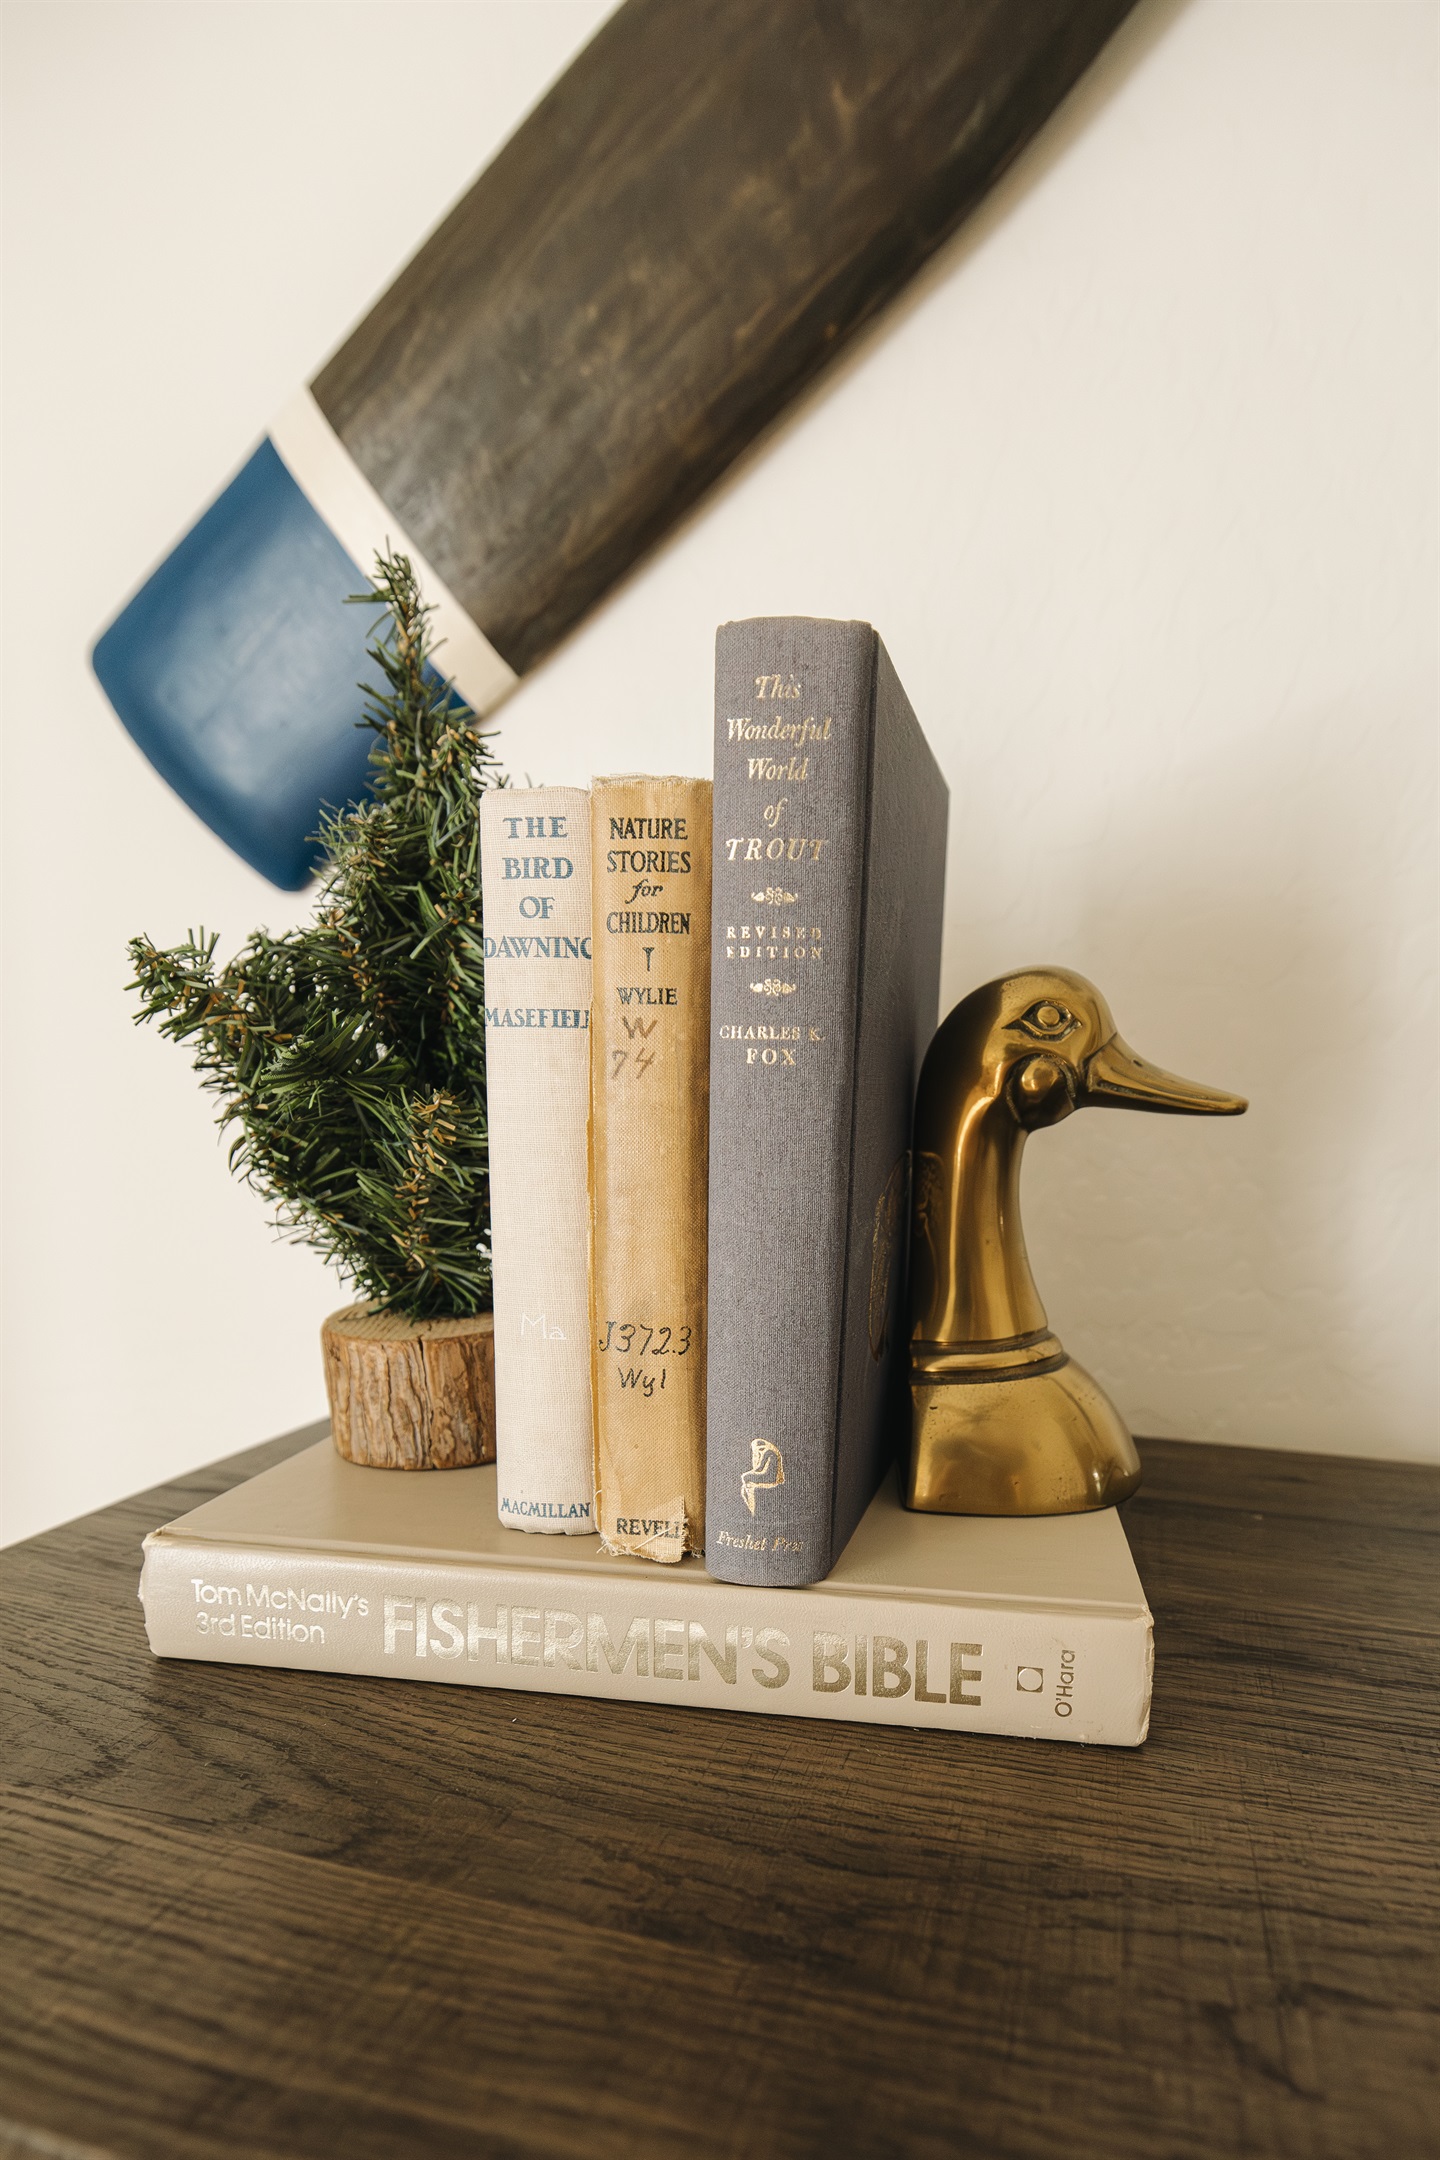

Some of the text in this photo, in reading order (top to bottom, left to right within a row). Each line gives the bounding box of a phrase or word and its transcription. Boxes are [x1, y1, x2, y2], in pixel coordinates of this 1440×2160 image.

[755, 673, 801, 701] This
[727, 715, 832, 748] Wonderful
[747, 757, 809, 781] World
[763, 798, 788, 828] of
[503, 816, 569, 839] THE
[609, 817, 688, 840] NATURE
[725, 837, 829, 861] TROUT
[502, 857, 574, 880] BIRD
[606, 850, 692, 874] STORIES
[625, 879, 664, 904] for
[519, 896, 555, 919] OF
[606, 912, 691, 934] CHILDREN
[726, 926, 822, 940] REVISED
[726, 946, 822, 960] EDITION
[616, 987, 677, 1006] WYLIE
[621, 1015, 659, 1040] W
[719, 1025, 801, 1042] CHARLES
[746, 1048, 796, 1067] FOX
[521, 1311, 567, 1340] Ma
[599, 1321, 692, 1356] J372.3
[501, 1497, 590, 1519] MACMILLAN
[716, 1531, 767, 1551] Freshet
[191, 1579, 369, 1619] Tom McNally's
[196, 1612, 325, 1644] 3rd Edition
[383, 1594, 985, 1706] FISHERMEN'S BIBLE
[1054, 1649, 1076, 1717] O'Hara
